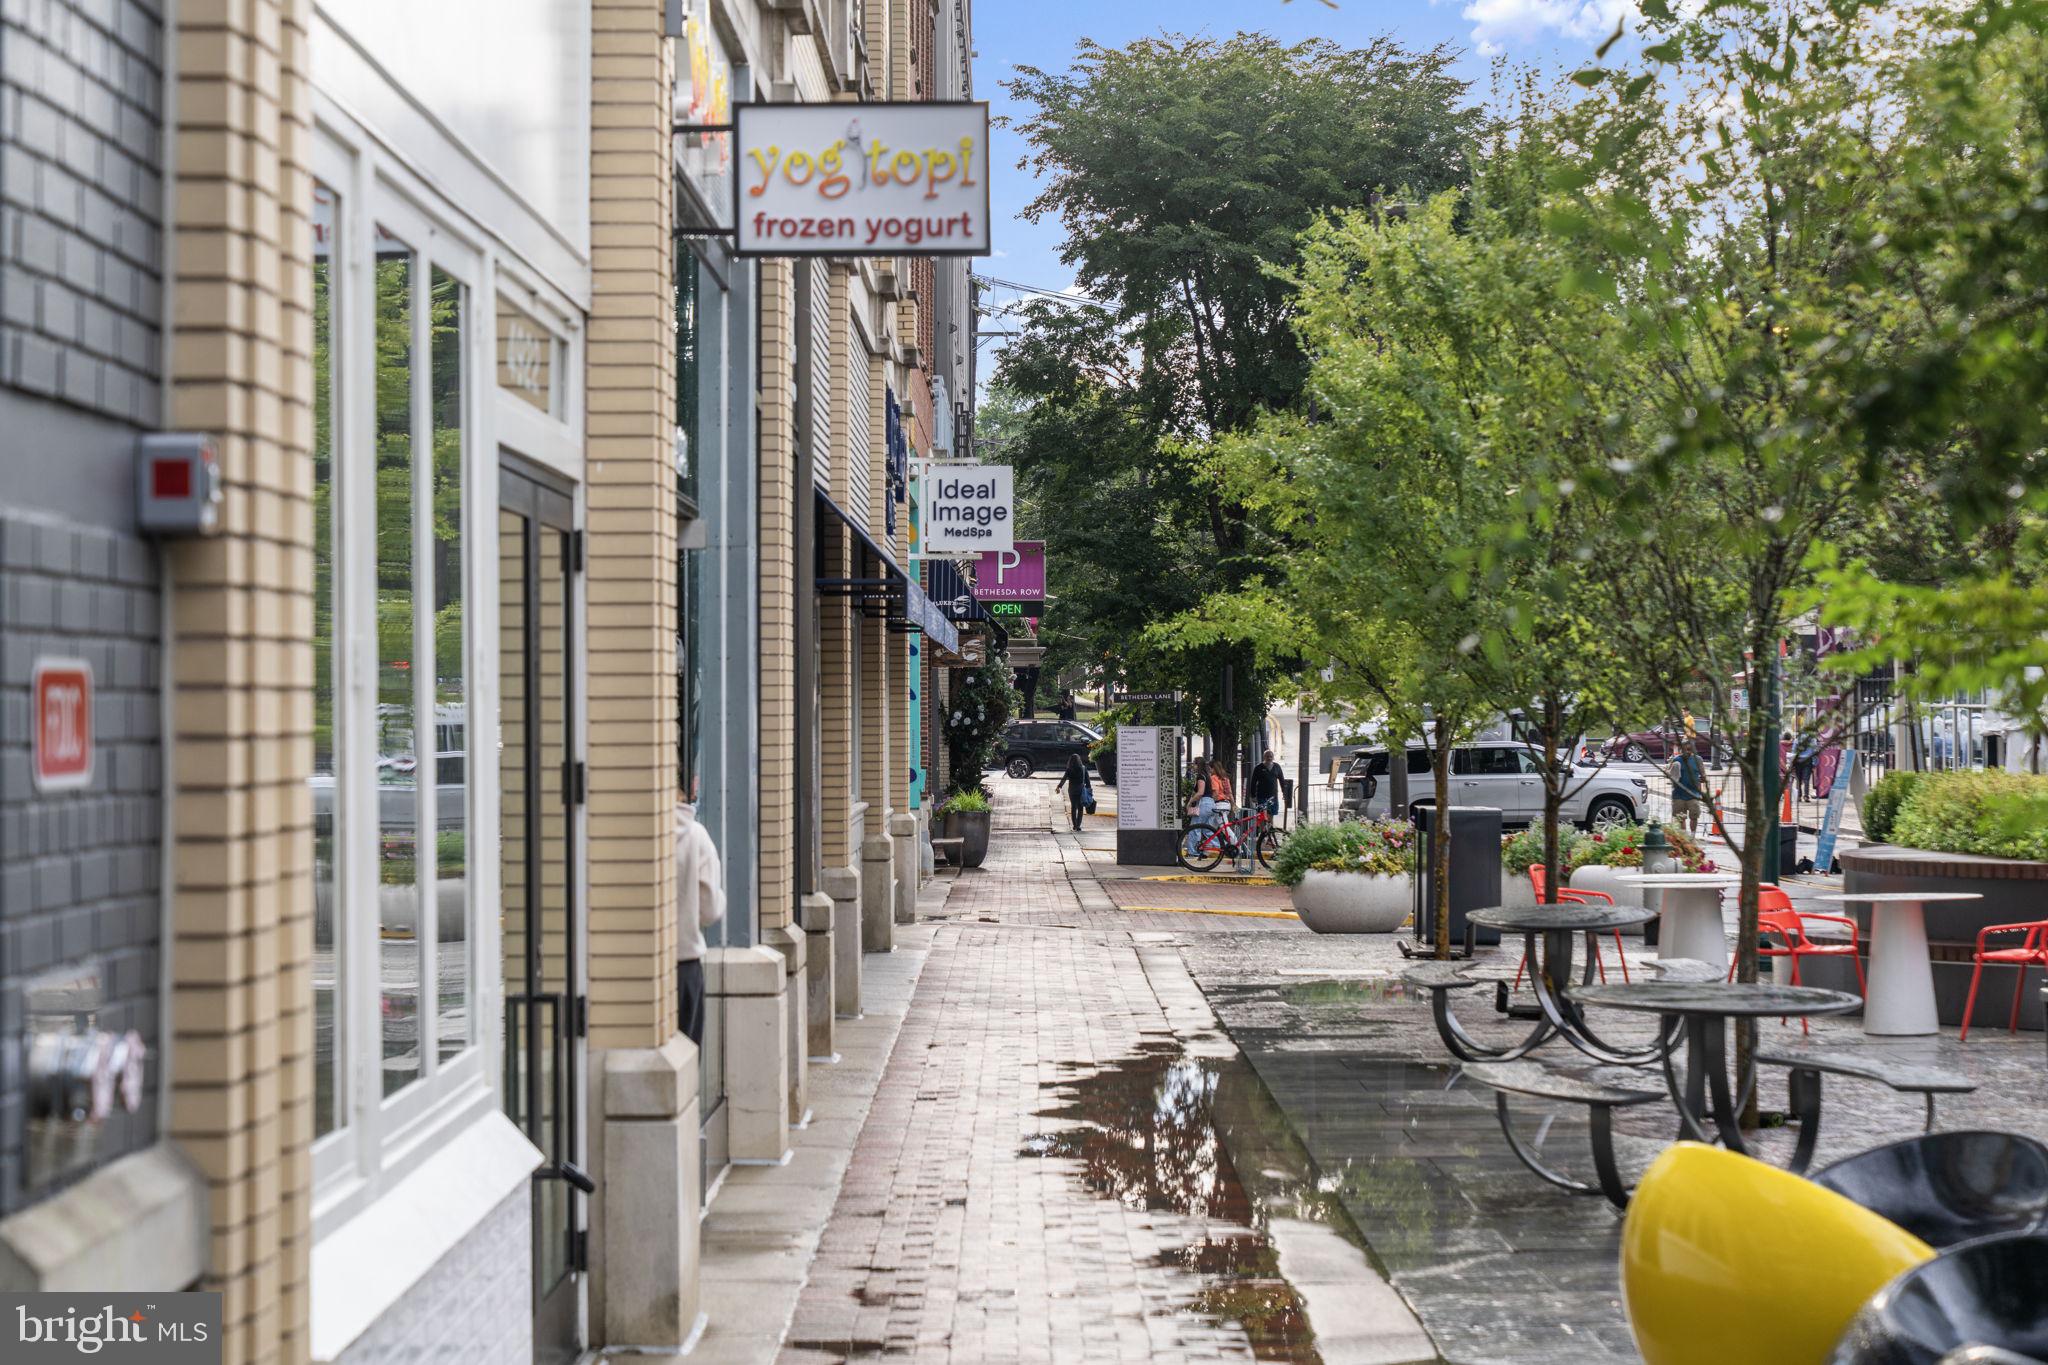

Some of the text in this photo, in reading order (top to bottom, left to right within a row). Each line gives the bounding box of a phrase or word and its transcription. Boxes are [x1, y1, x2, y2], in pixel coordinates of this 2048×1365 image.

[753, 212, 973, 244] frozen yogurt
[938, 479, 996, 499] Ideal
[933, 502, 1008, 525] Image
[944, 527, 993, 539] MedSpa
[997, 550, 1021, 585] P
[974, 588, 1040, 596] BETHESDA ROW
[992, 603, 1022, 615] OPEN
